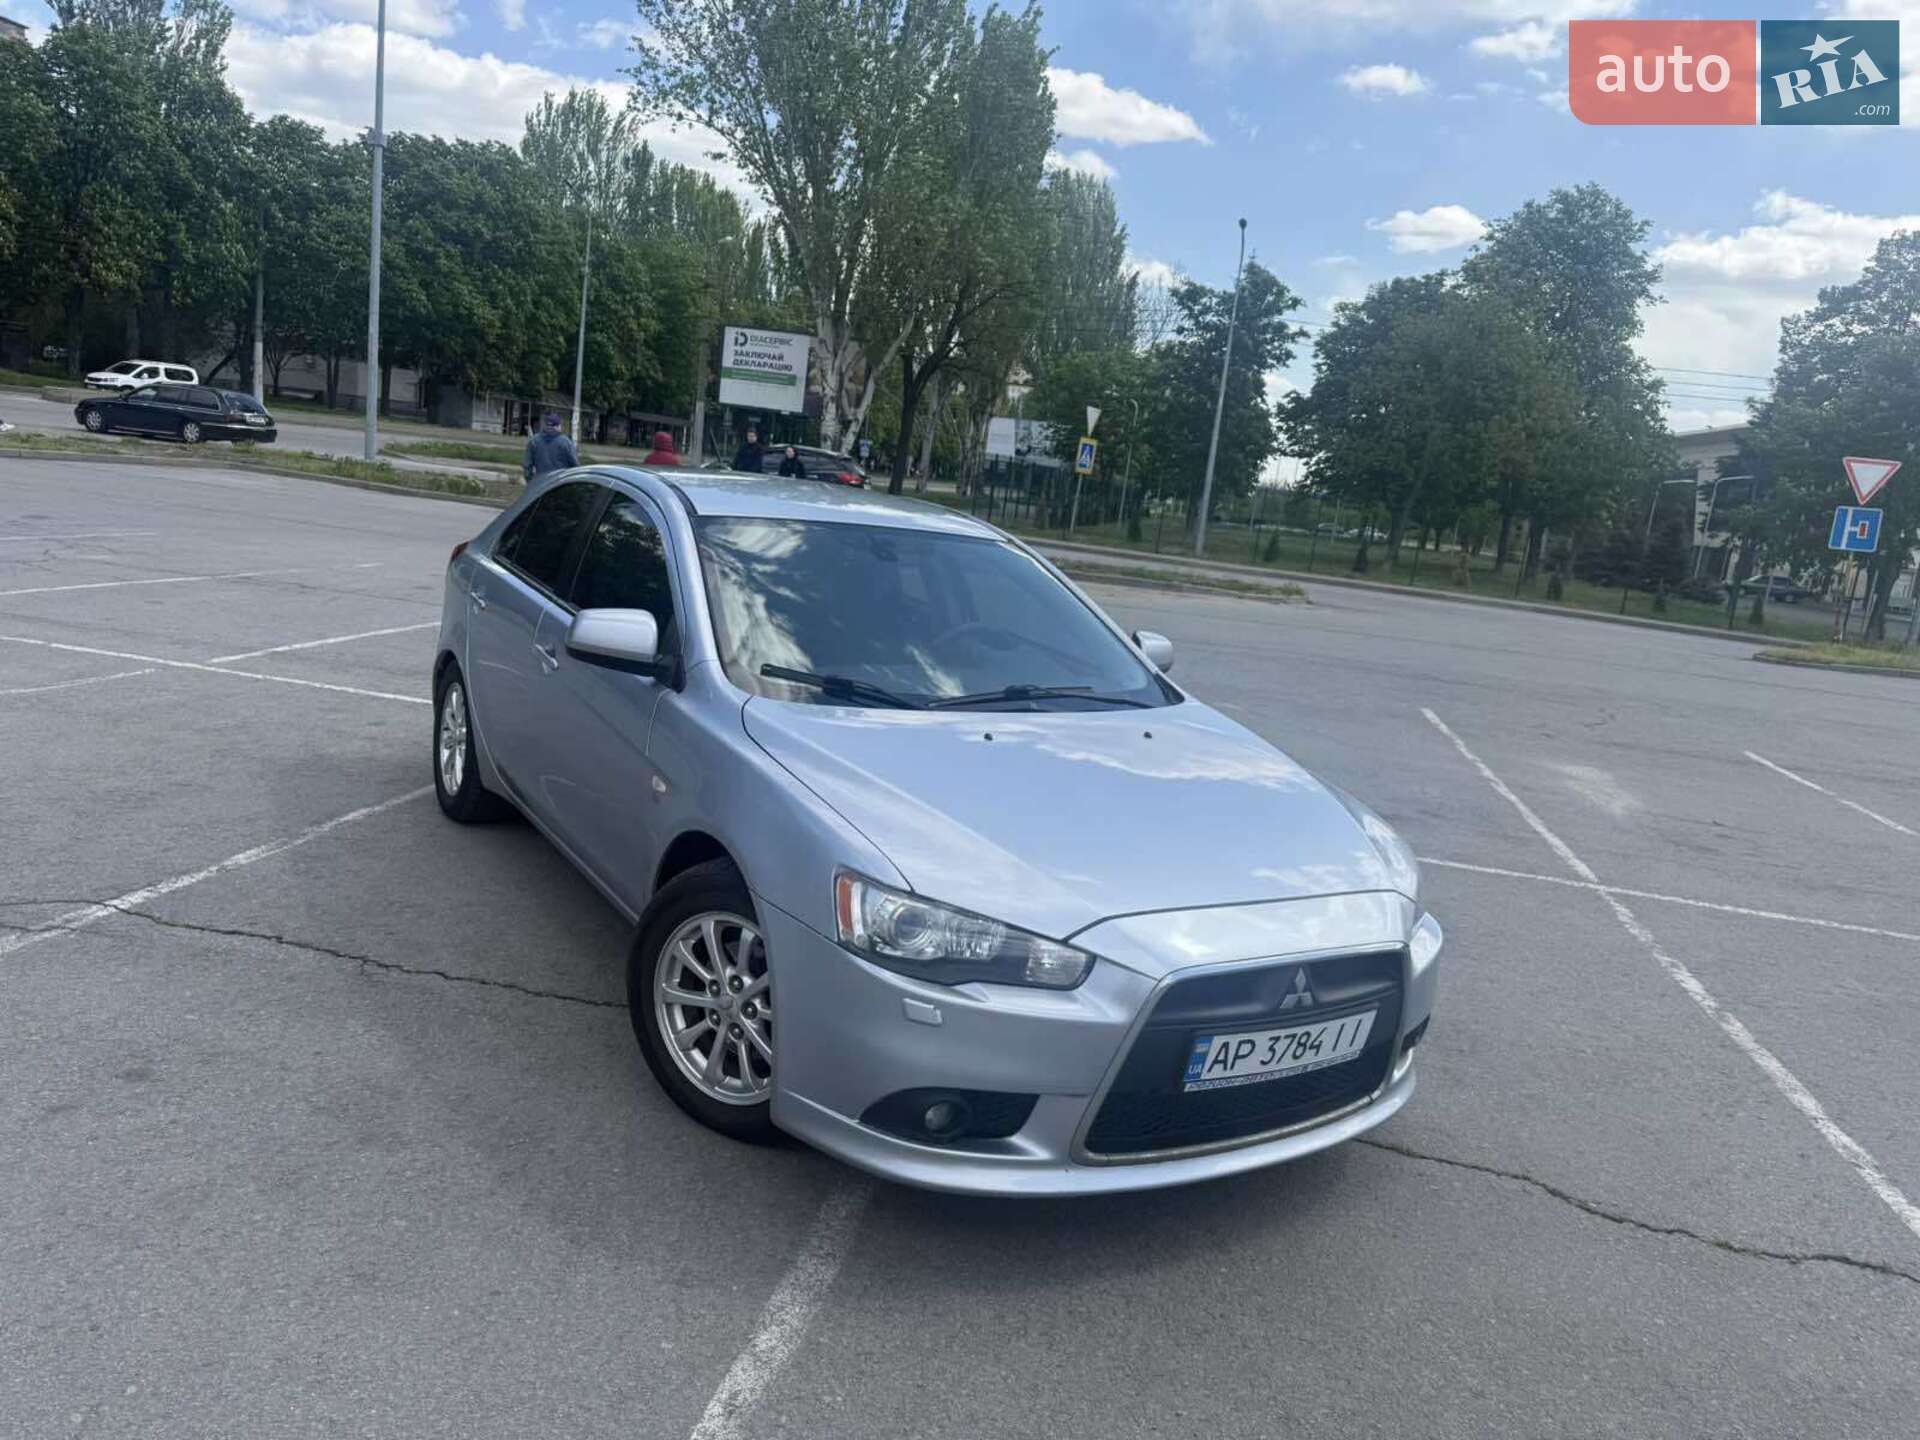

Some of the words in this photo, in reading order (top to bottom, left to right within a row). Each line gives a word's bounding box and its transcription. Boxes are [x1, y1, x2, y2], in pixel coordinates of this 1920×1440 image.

[1206, 1038, 1256, 1073] AP
[1260, 1026, 1327, 1066] 3784
[1188, 1064, 1202, 1074] UA
